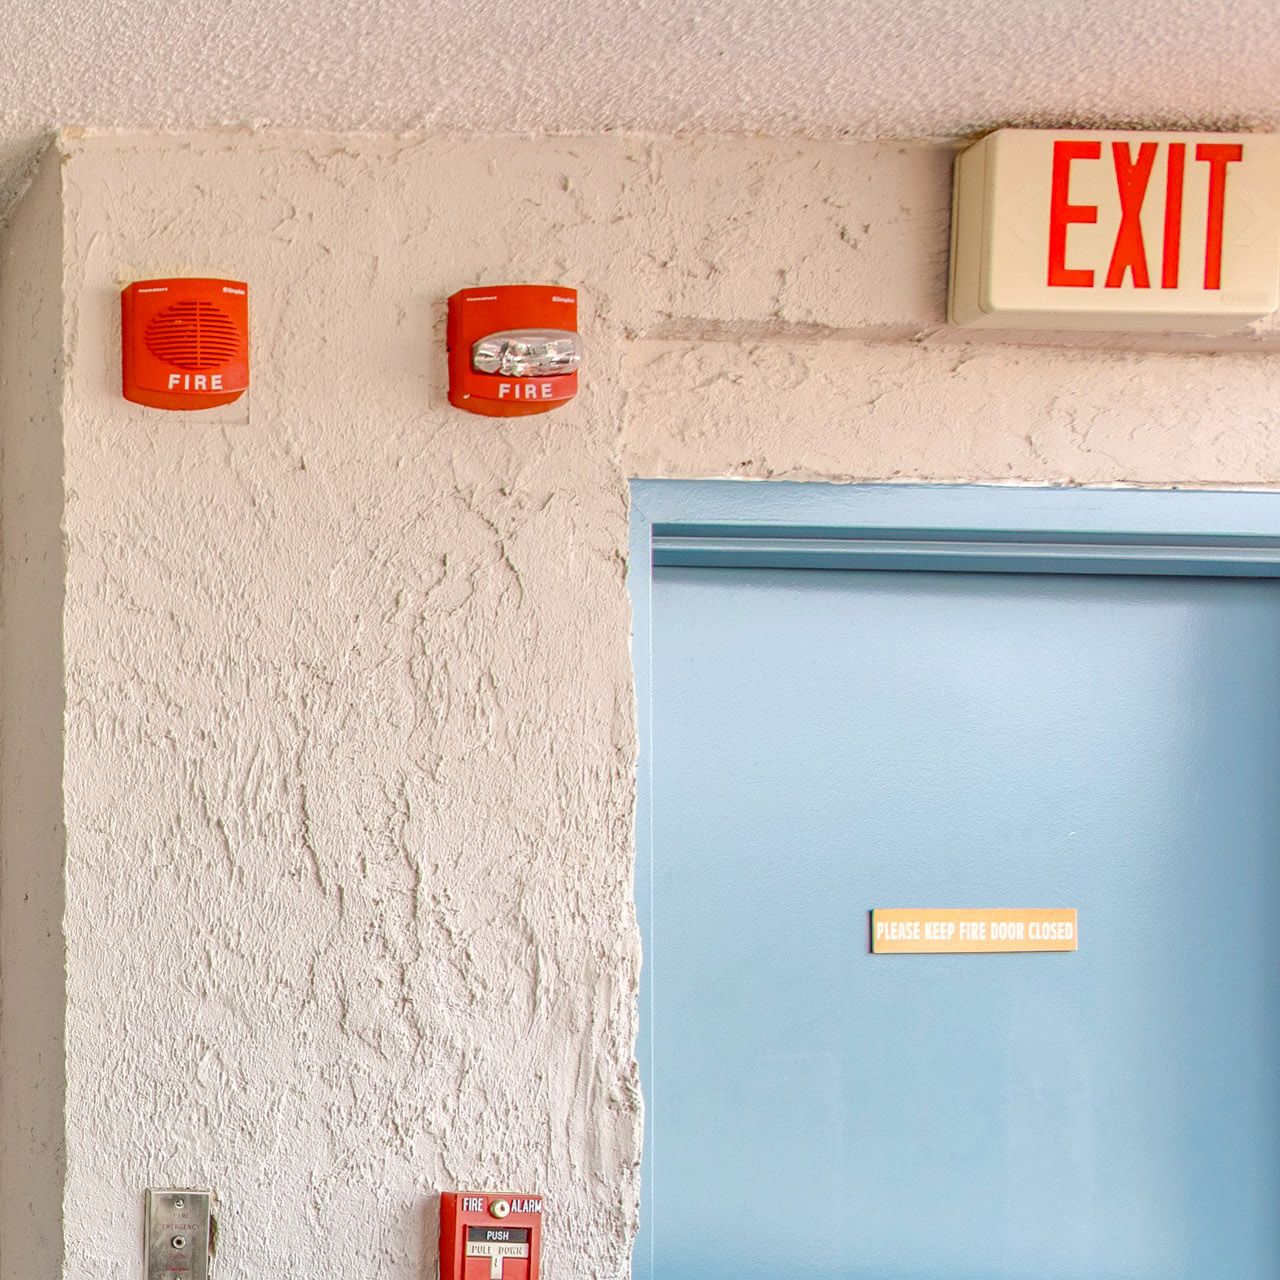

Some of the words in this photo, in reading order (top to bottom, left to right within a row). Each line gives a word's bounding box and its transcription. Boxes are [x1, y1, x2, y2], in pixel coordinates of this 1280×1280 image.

[1047, 140, 1243, 290] EXIT
[168, 373, 223, 391] FIRE
[498, 383, 554, 399] FIRE
[876, 921, 921, 940] PLEASE
[924, 921, 956, 940] KEEP
[959, 921, 986, 940] FIRE
[990, 921, 1025, 940] DOOR
[1028, 921, 1074, 940] CLOSED
[462, 1198, 484, 1212] FIRE
[511, 1199, 542, 1213] ALARM
[486, 1231, 510, 1241] PUSH
